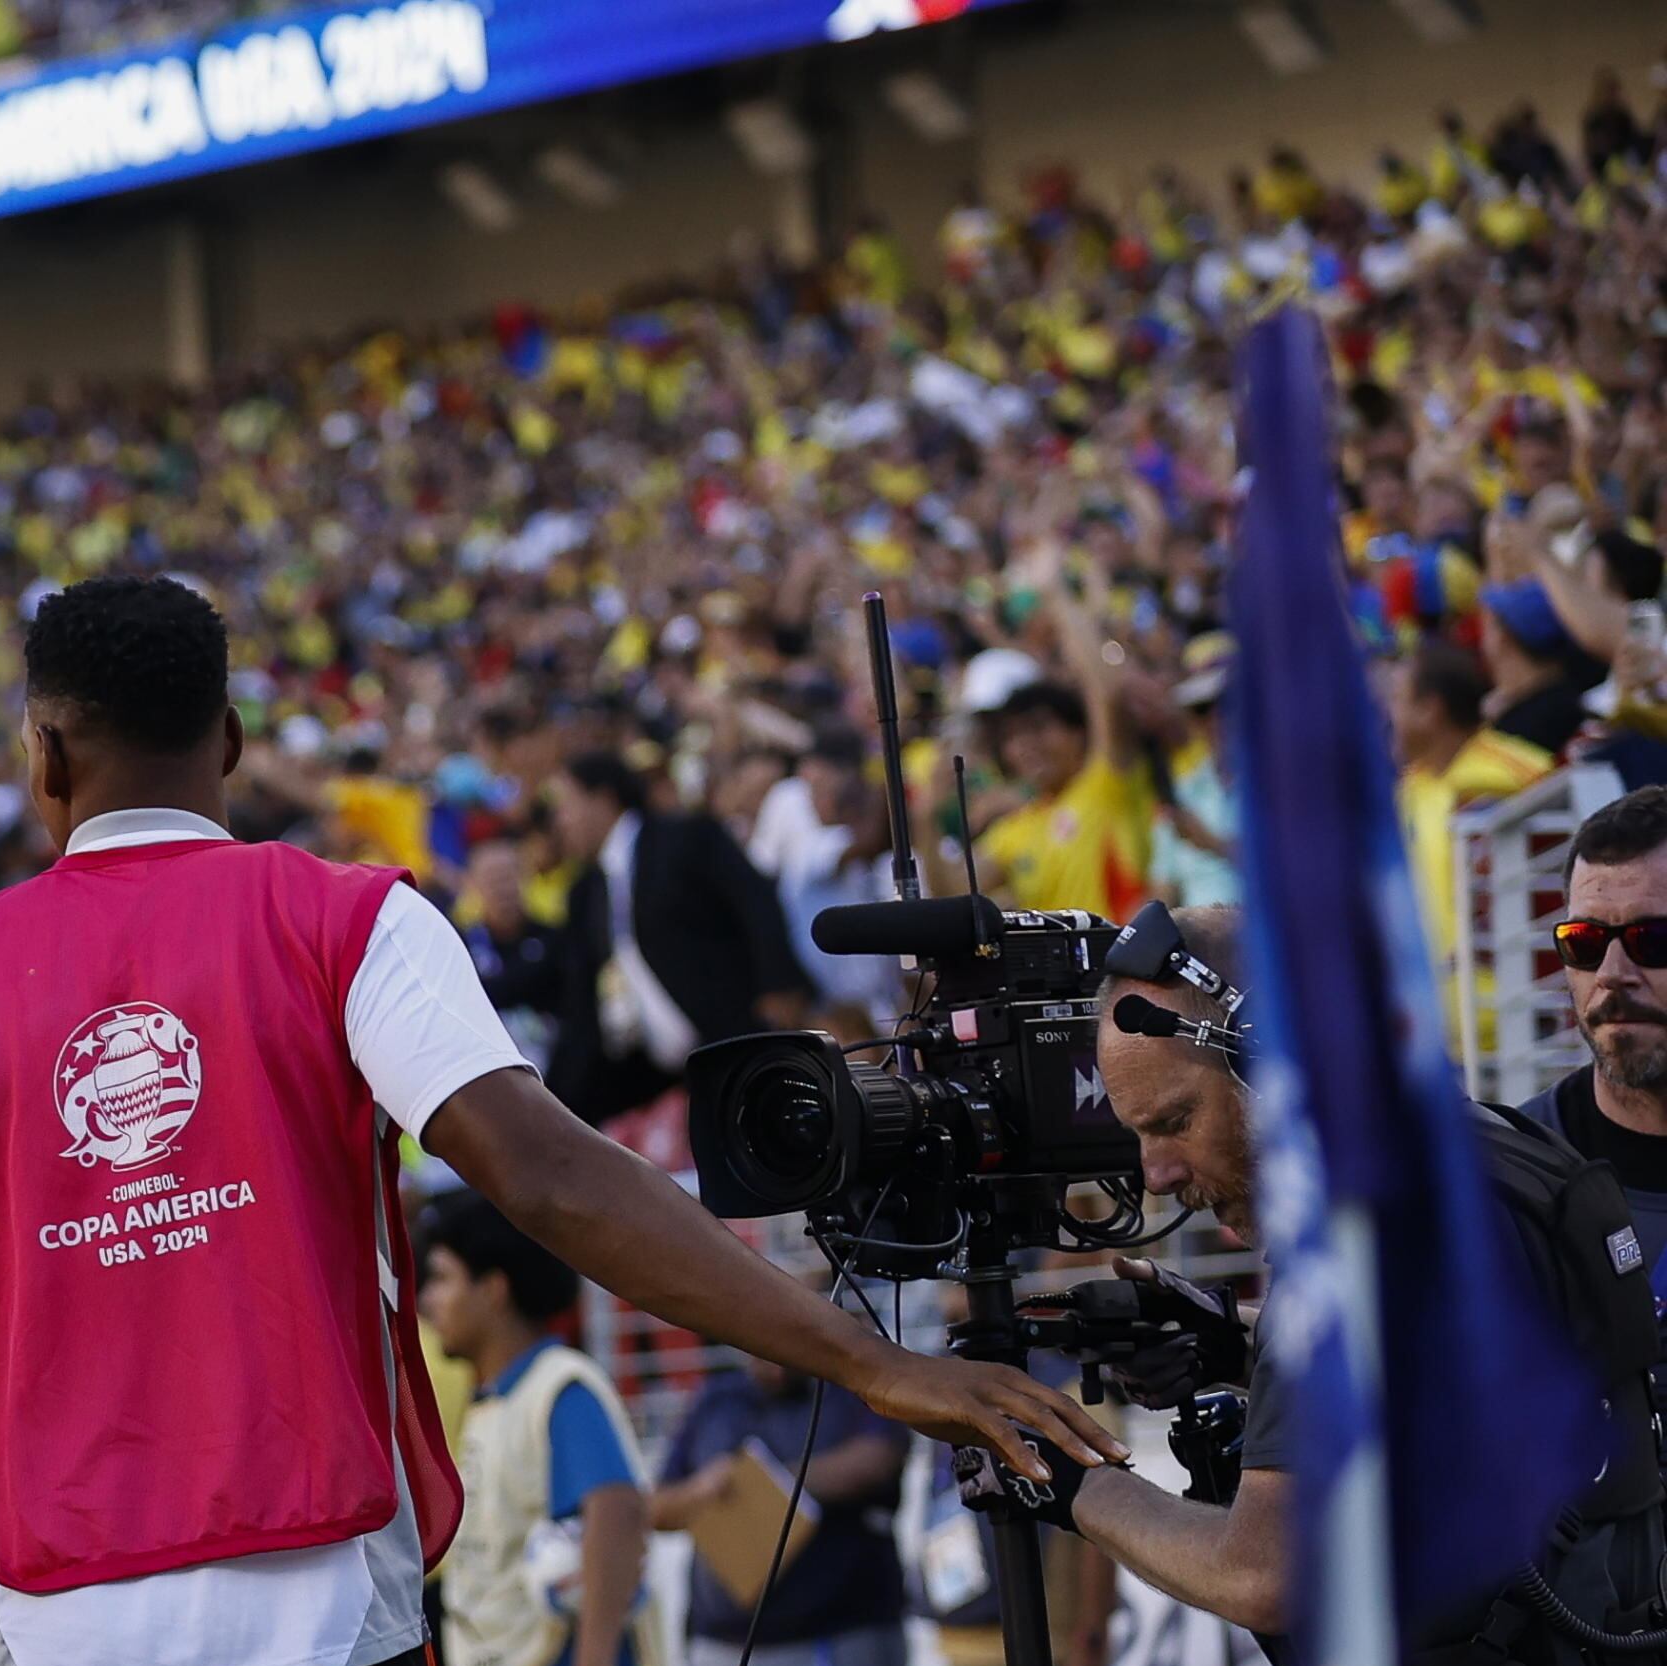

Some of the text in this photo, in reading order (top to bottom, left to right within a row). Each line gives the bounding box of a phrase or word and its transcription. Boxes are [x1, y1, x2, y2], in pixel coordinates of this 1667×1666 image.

[1036, 1031, 1071, 1043] SONY
[39, 1180, 256, 1249] COPA AMERICA
[99, 1225, 208, 1267] USA 2024
